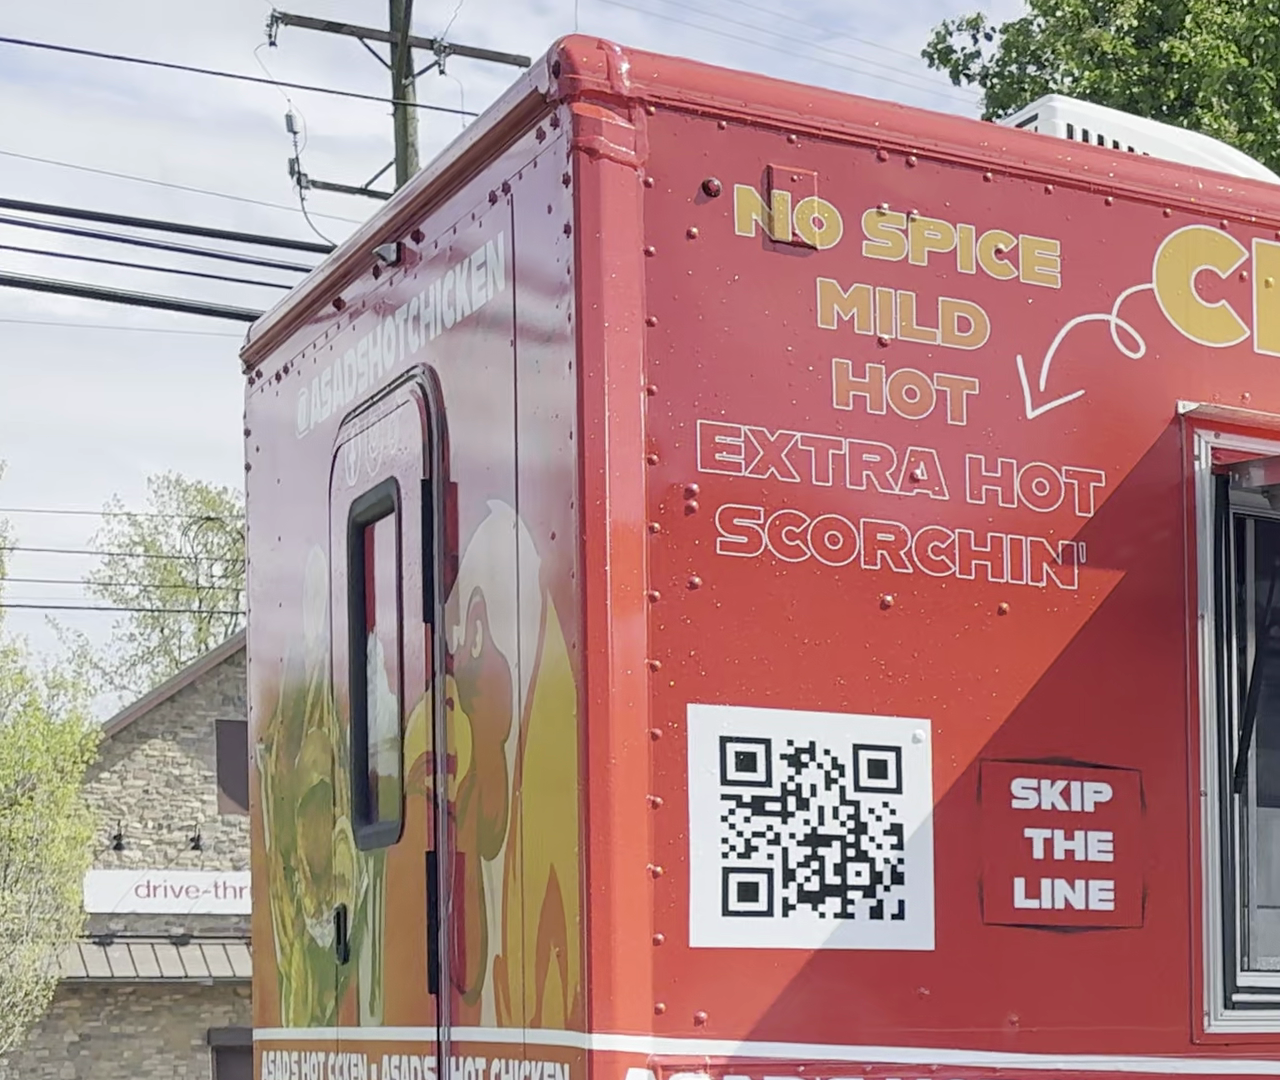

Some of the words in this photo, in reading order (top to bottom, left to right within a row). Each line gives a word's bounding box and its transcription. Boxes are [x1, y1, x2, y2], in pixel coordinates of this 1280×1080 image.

[734, 184, 843, 250] NO
[861, 208, 1061, 288] SPICE
[816, 277, 990, 351] MILD
[832, 358, 979, 426] HOT
[697, 420, 949, 500] EXTRA
[966, 453, 1106, 517] HOT
[715, 503, 1086, 590] SCORCHIN'
[1010, 777, 1113, 813] SKIP
[1023, 827, 1114, 862] THE
[134, 878, 252, 902] drive-thr
[1013, 876, 1115, 911] LINE
